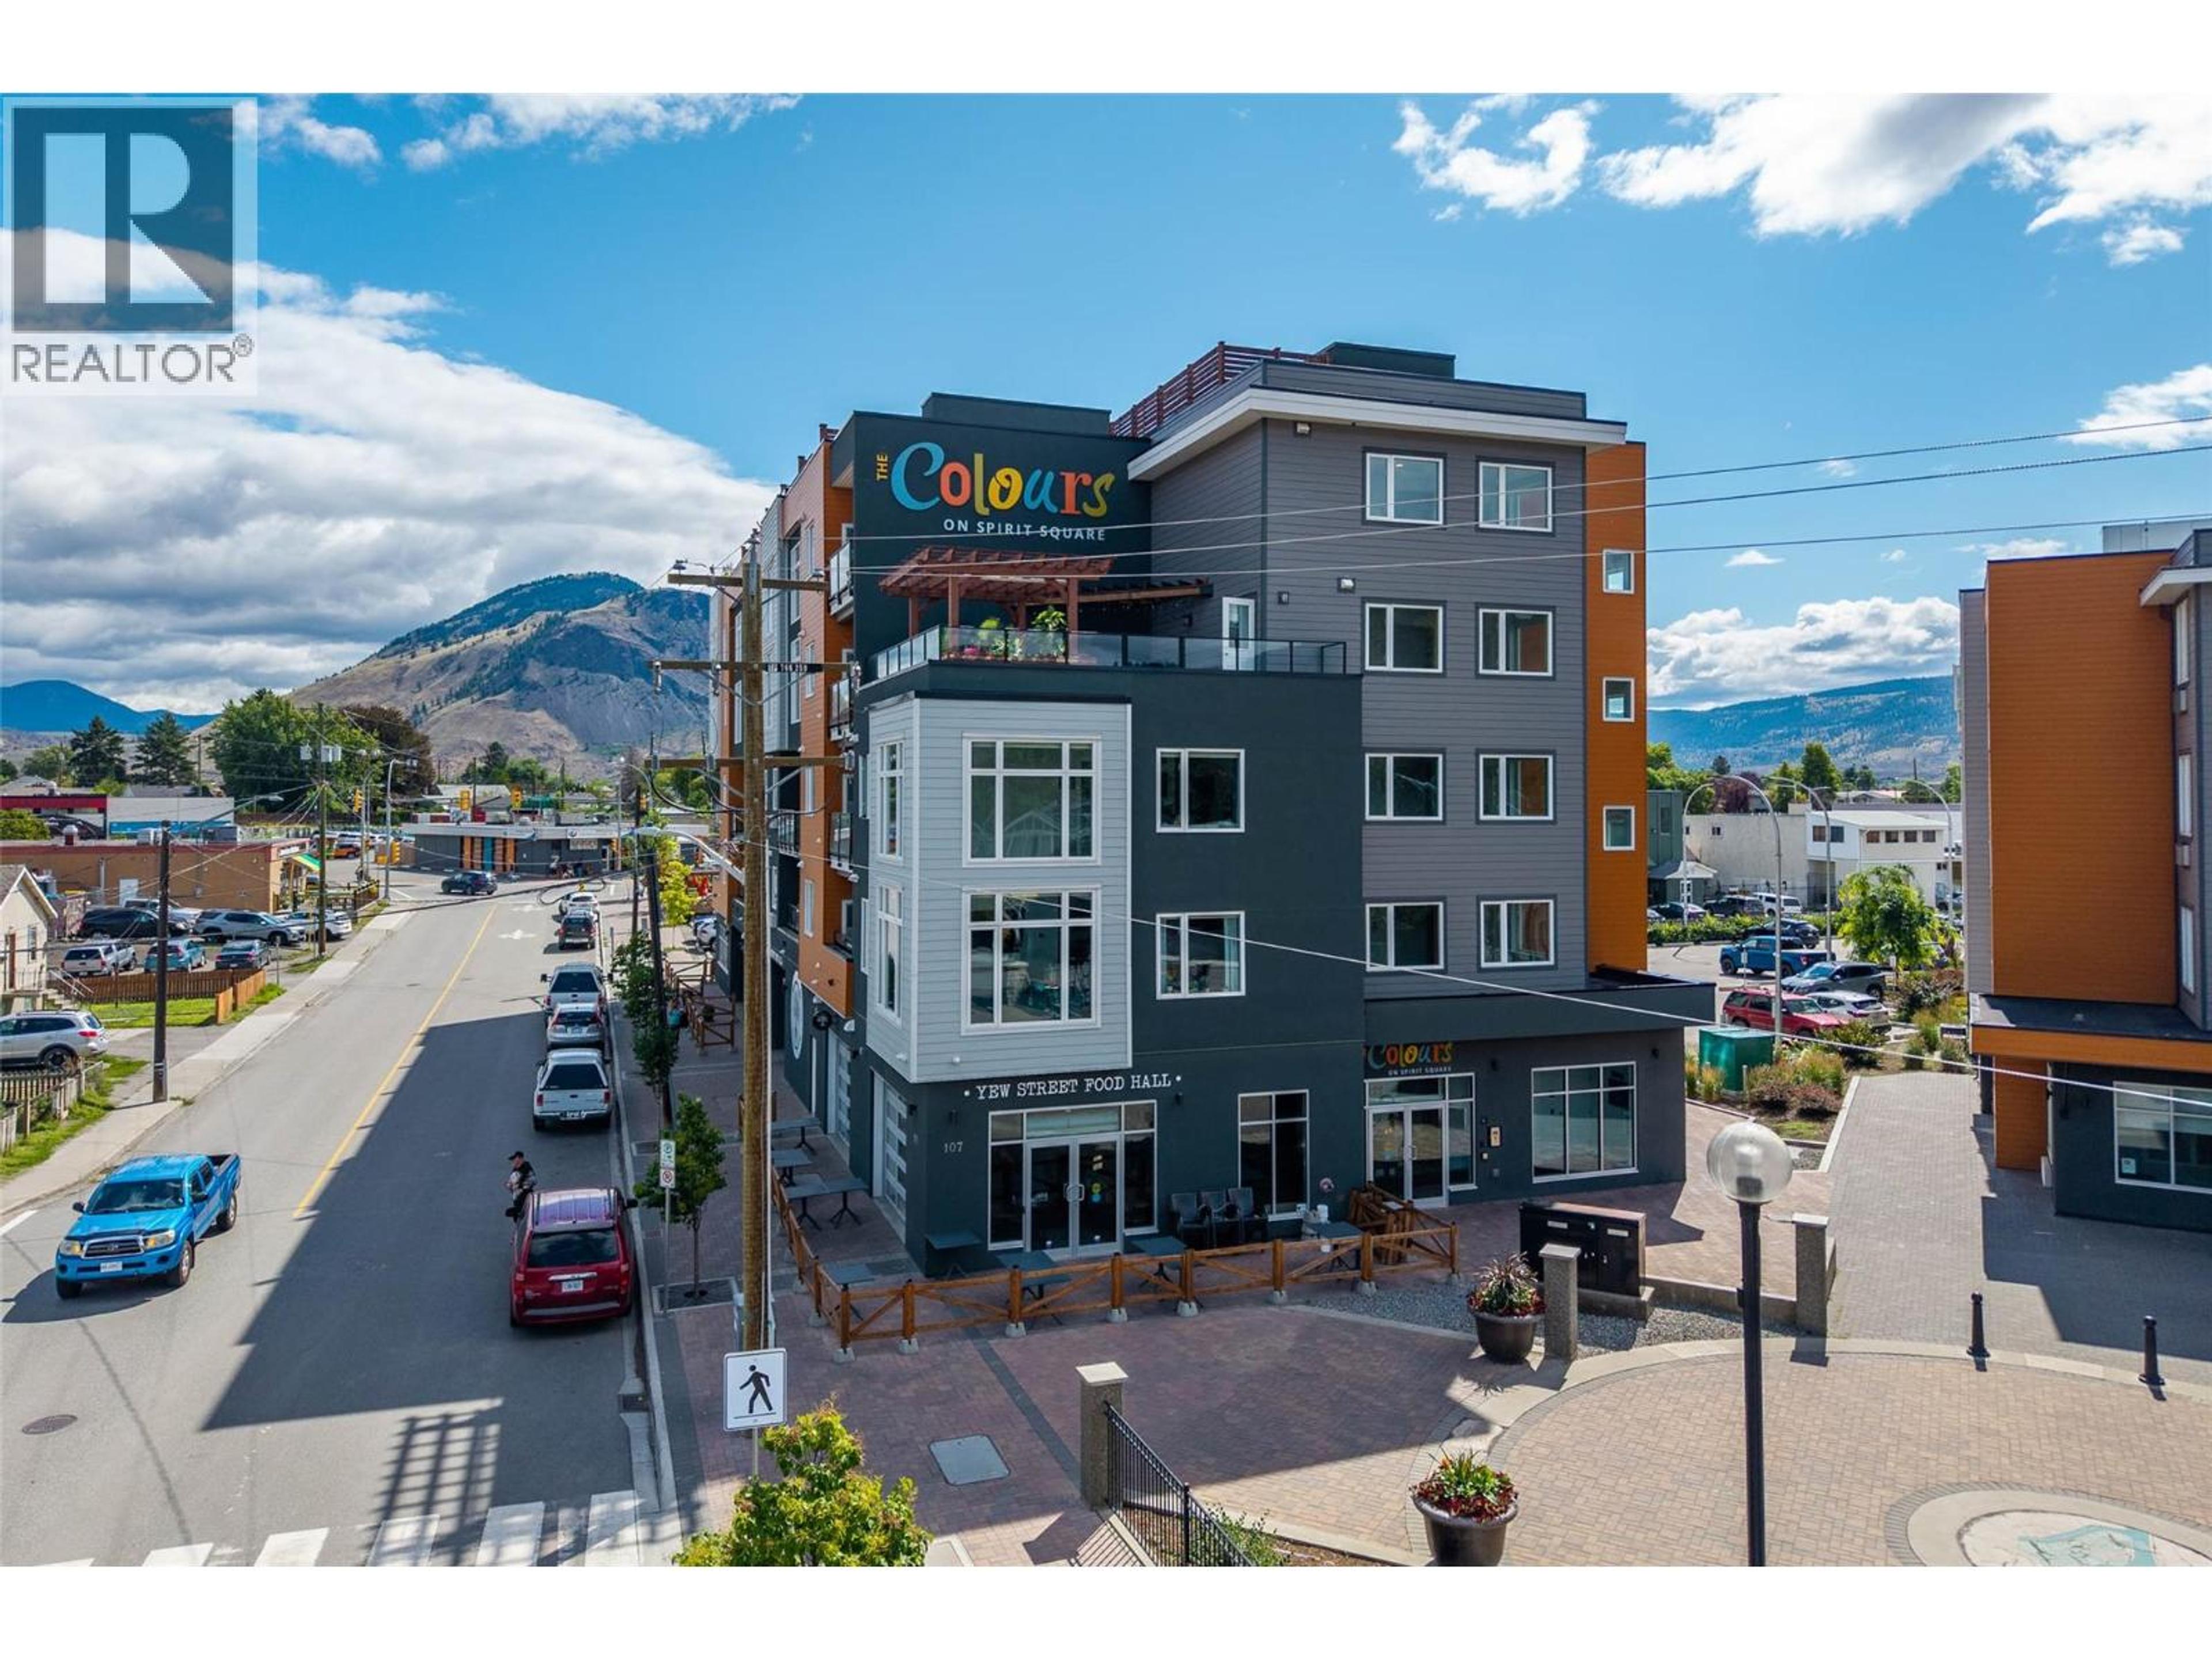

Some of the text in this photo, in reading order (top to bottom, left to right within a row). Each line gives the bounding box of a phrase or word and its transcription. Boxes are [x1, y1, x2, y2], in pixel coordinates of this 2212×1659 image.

[876, 453, 888, 480] THE
[891, 442, 1115, 517] Colours
[944, 519, 1105, 541] ON SPIRIT SQUARE
[976, 1074, 1171, 1100] YEW STREET FOOD HALL
[944, 1141, 963, 1153] 107
